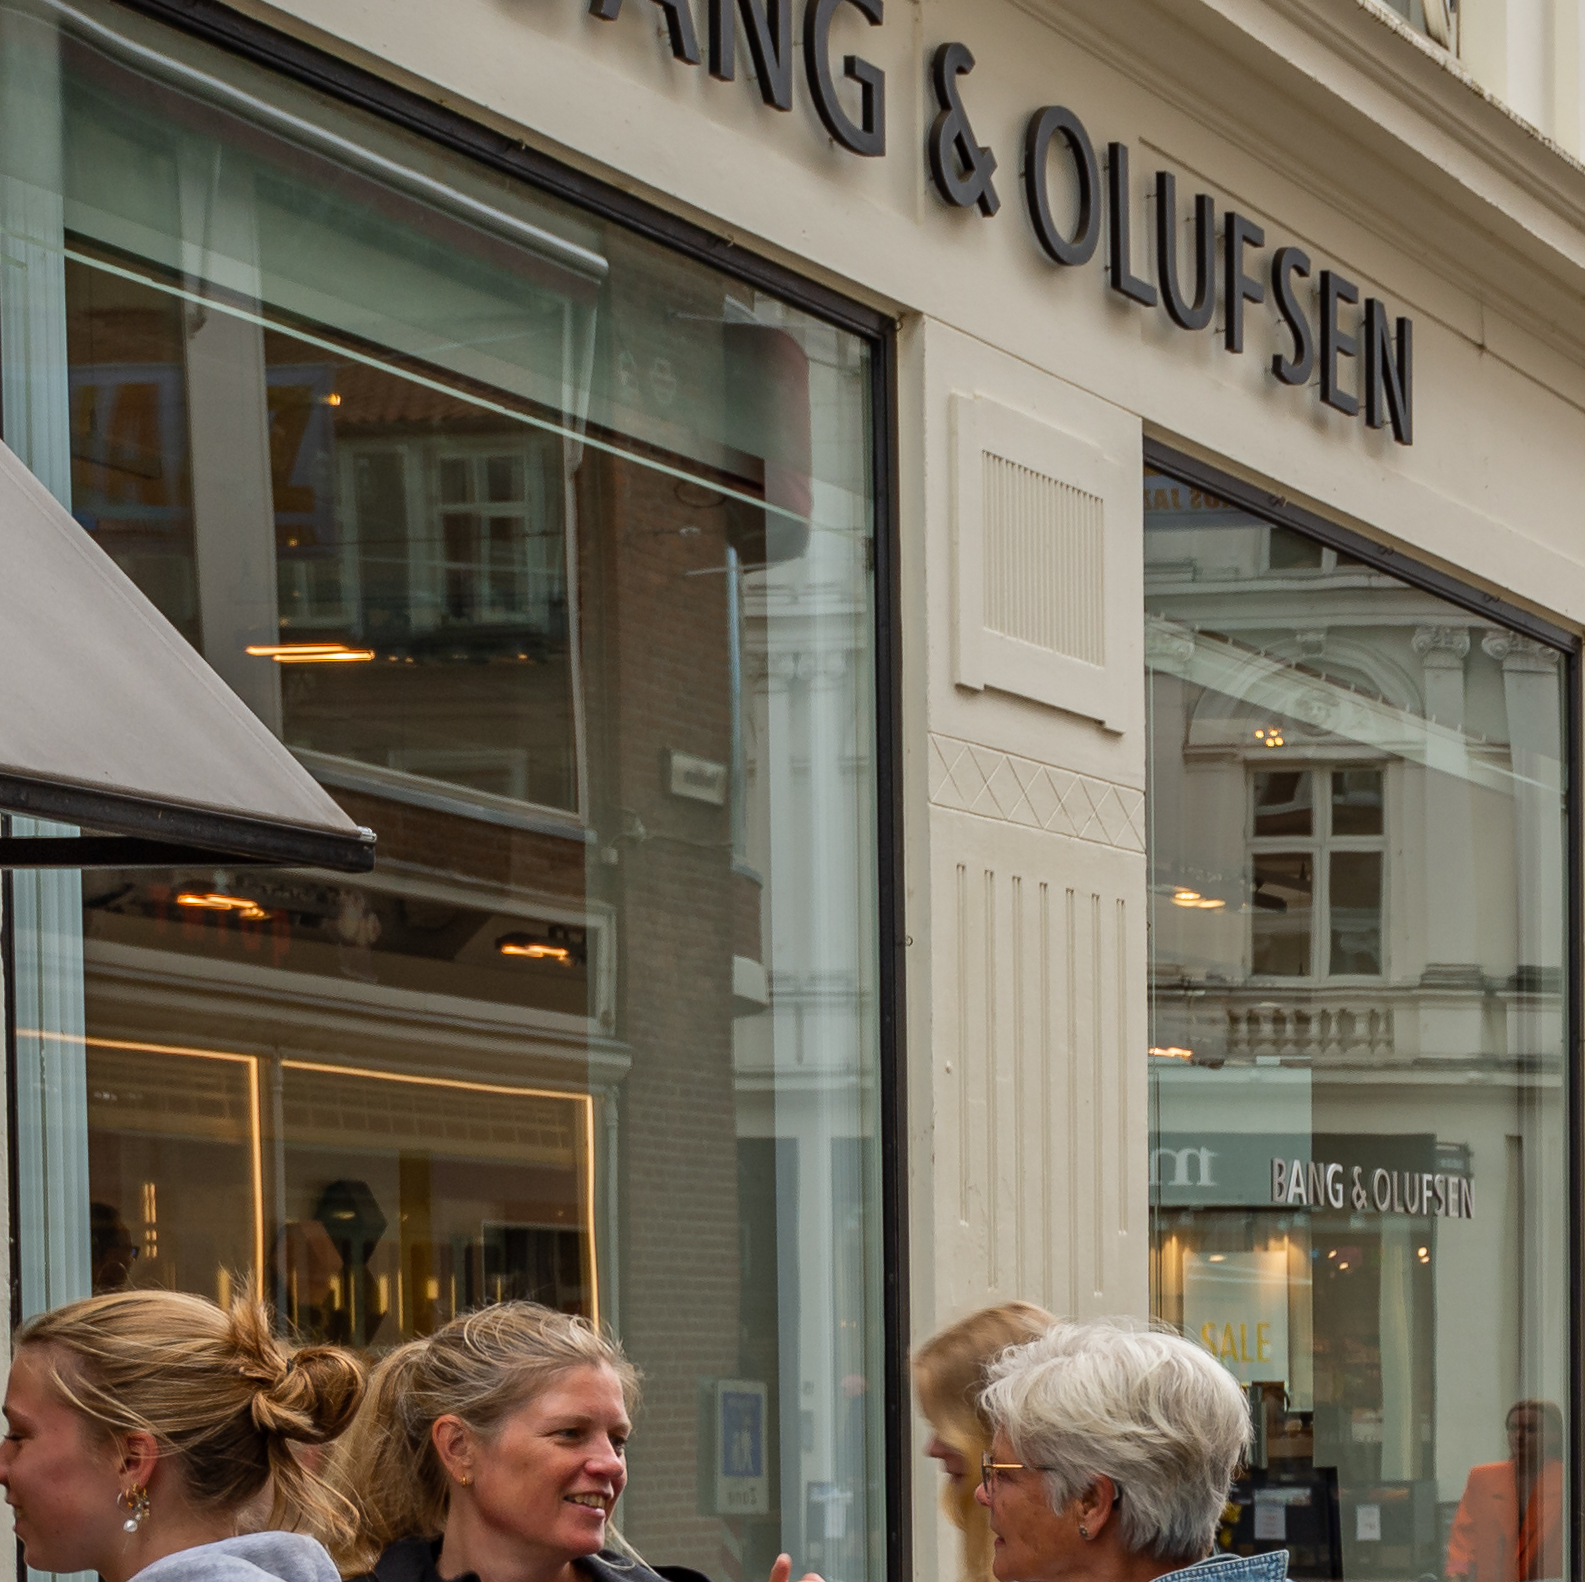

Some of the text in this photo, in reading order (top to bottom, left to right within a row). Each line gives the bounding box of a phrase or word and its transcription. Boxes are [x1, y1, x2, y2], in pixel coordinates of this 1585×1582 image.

[929, 42, 1001, 217] &
[1024, 105, 1413, 446] OLUFSEN
[1271, 1157, 1476, 1220] BANG & OLUFSEN
[1201, 1321, 1271, 1363] SALE
